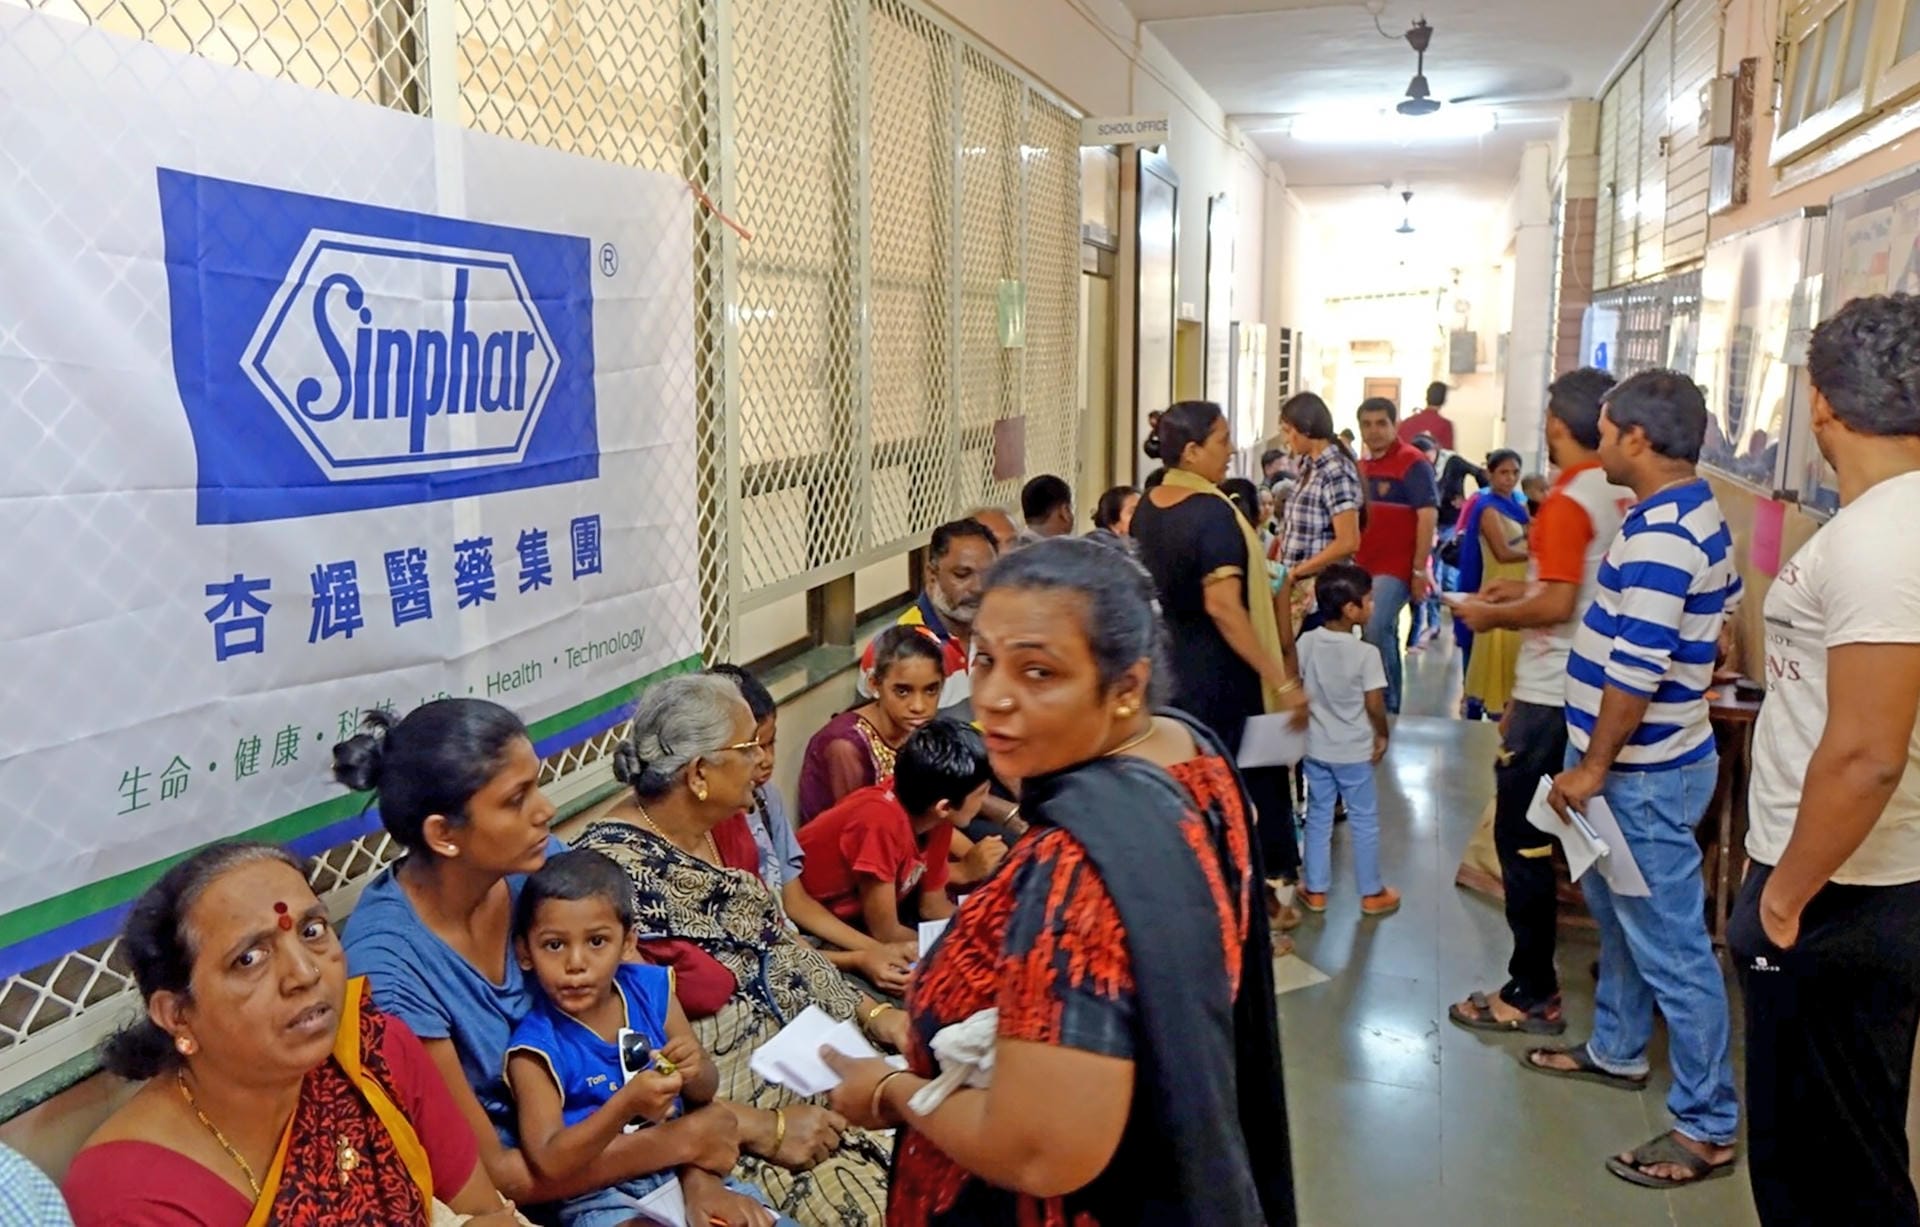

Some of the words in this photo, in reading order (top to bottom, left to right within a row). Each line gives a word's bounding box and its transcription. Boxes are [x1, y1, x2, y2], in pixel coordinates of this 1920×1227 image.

[1097, 122, 1134, 136] SCHOOL
[1136, 119, 1168, 133] OFFICE
[296, 267, 536, 454] Sinphar
[204, 514, 603, 662] 杏輝醫藥集團
[486, 659, 543, 698] Health
[564, 625, 646, 670] Technology
[585, 1073, 608, 1088] Tom
